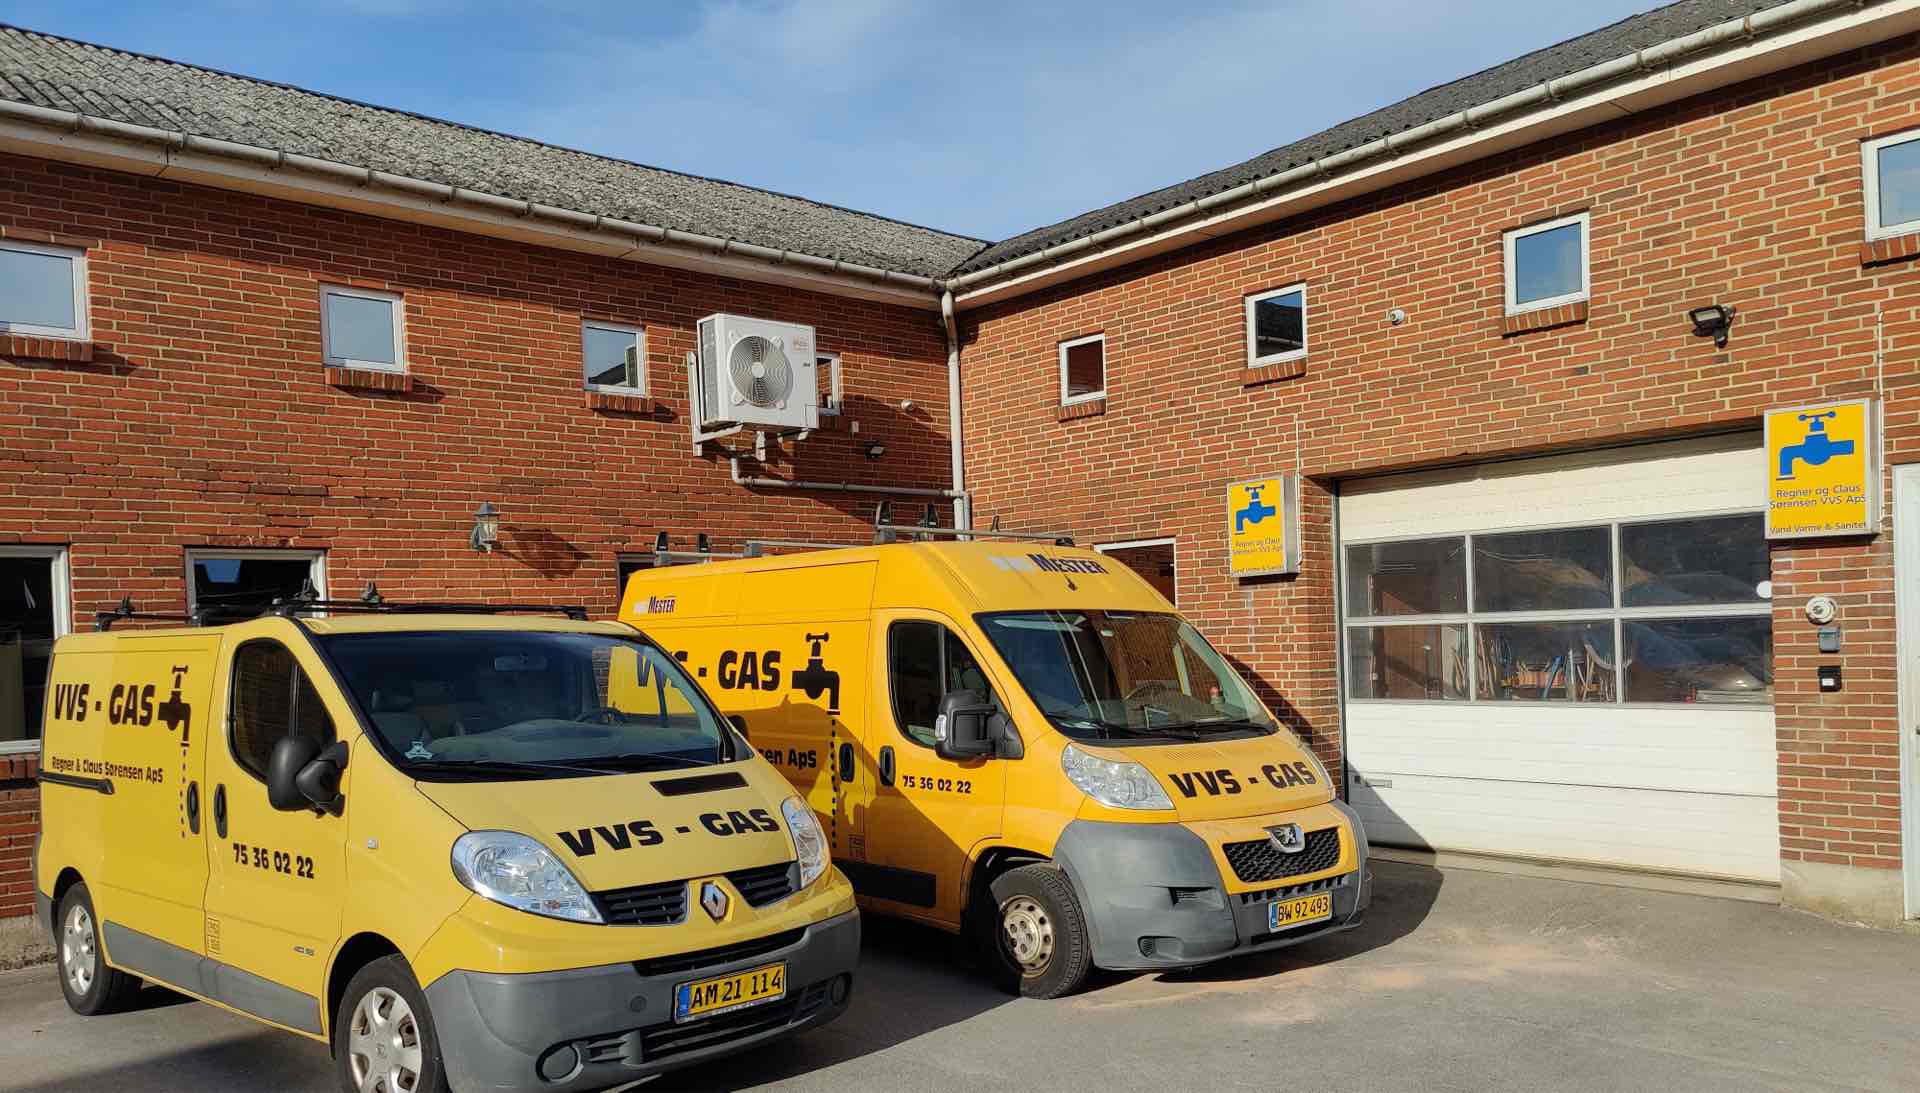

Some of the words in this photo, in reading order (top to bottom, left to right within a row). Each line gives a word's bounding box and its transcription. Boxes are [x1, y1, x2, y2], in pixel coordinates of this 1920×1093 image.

[1815, 488, 1829, 496] og
[1832, 484, 1861, 493] Claus
[718, 650, 781, 691] GAS
[55, 683, 90, 722] VVS
[109, 683, 156, 727] GAS
[787, 748, 816, 769] ApS
[902, 775, 916, 788] 75
[919, 777, 934, 790] 36
[937, 778, 952, 792] 02
[956, 780, 972, 794] 22
[1168, 769, 1242, 798] VVS
[1261, 761, 1317, 789] GAS
[557, 820, 664, 857] VVS
[699, 808, 780, 836] GAS
[232, 842, 249, 865] 75
[252, 847, 269, 869] 36
[273, 850, 292, 874] 02
[296, 855, 315, 879] 22
[1278, 904, 1292, 922] BW
[1295, 902, 1307, 918] 92
[1310, 896, 1328, 915] 493
[691, 983, 718, 1009] AM
[722, 978, 741, 1001] 21
[751, 969, 781, 996] 114
